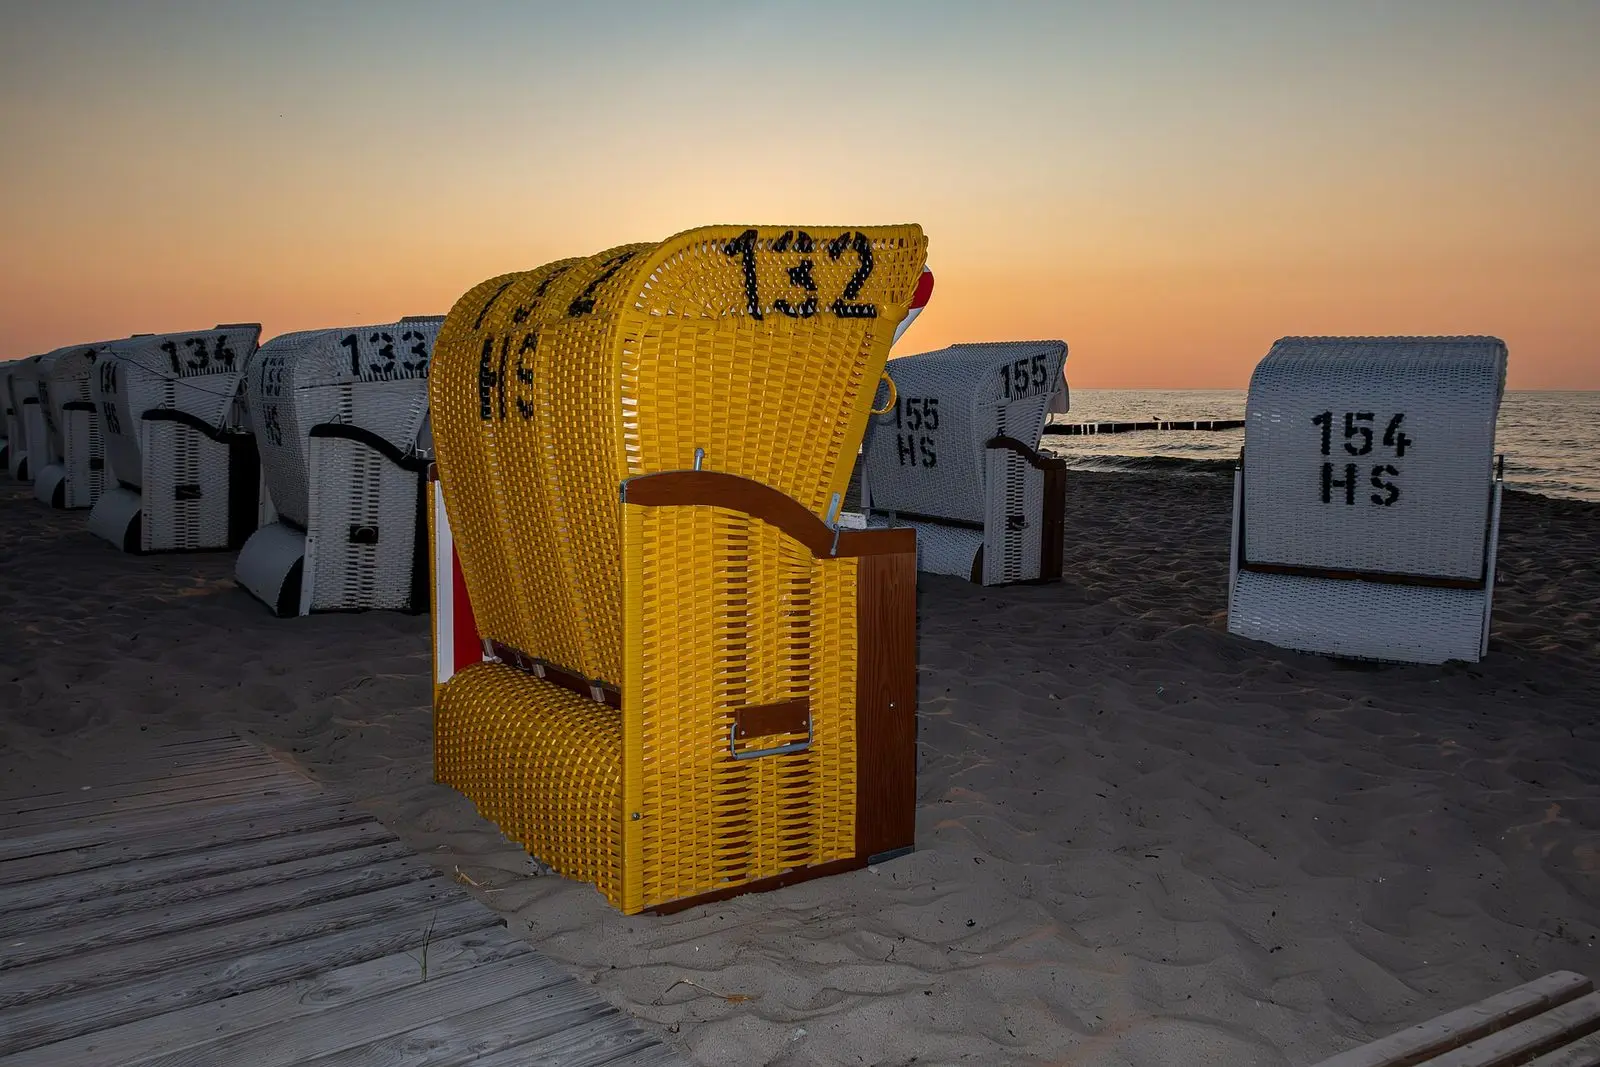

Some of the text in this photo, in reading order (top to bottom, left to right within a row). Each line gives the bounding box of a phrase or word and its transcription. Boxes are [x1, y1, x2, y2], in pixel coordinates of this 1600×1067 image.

[724, 229, 877, 320] 132
[161, 335, 235, 374] 134
[340, 330, 428, 377] 133
[1000, 354, 1047, 399] 155
[895, 394, 939, 431] 155
[1311, 410, 1412, 457] 154
[897, 434, 937, 468] HS
[1320, 462, 1400, 506] HS
